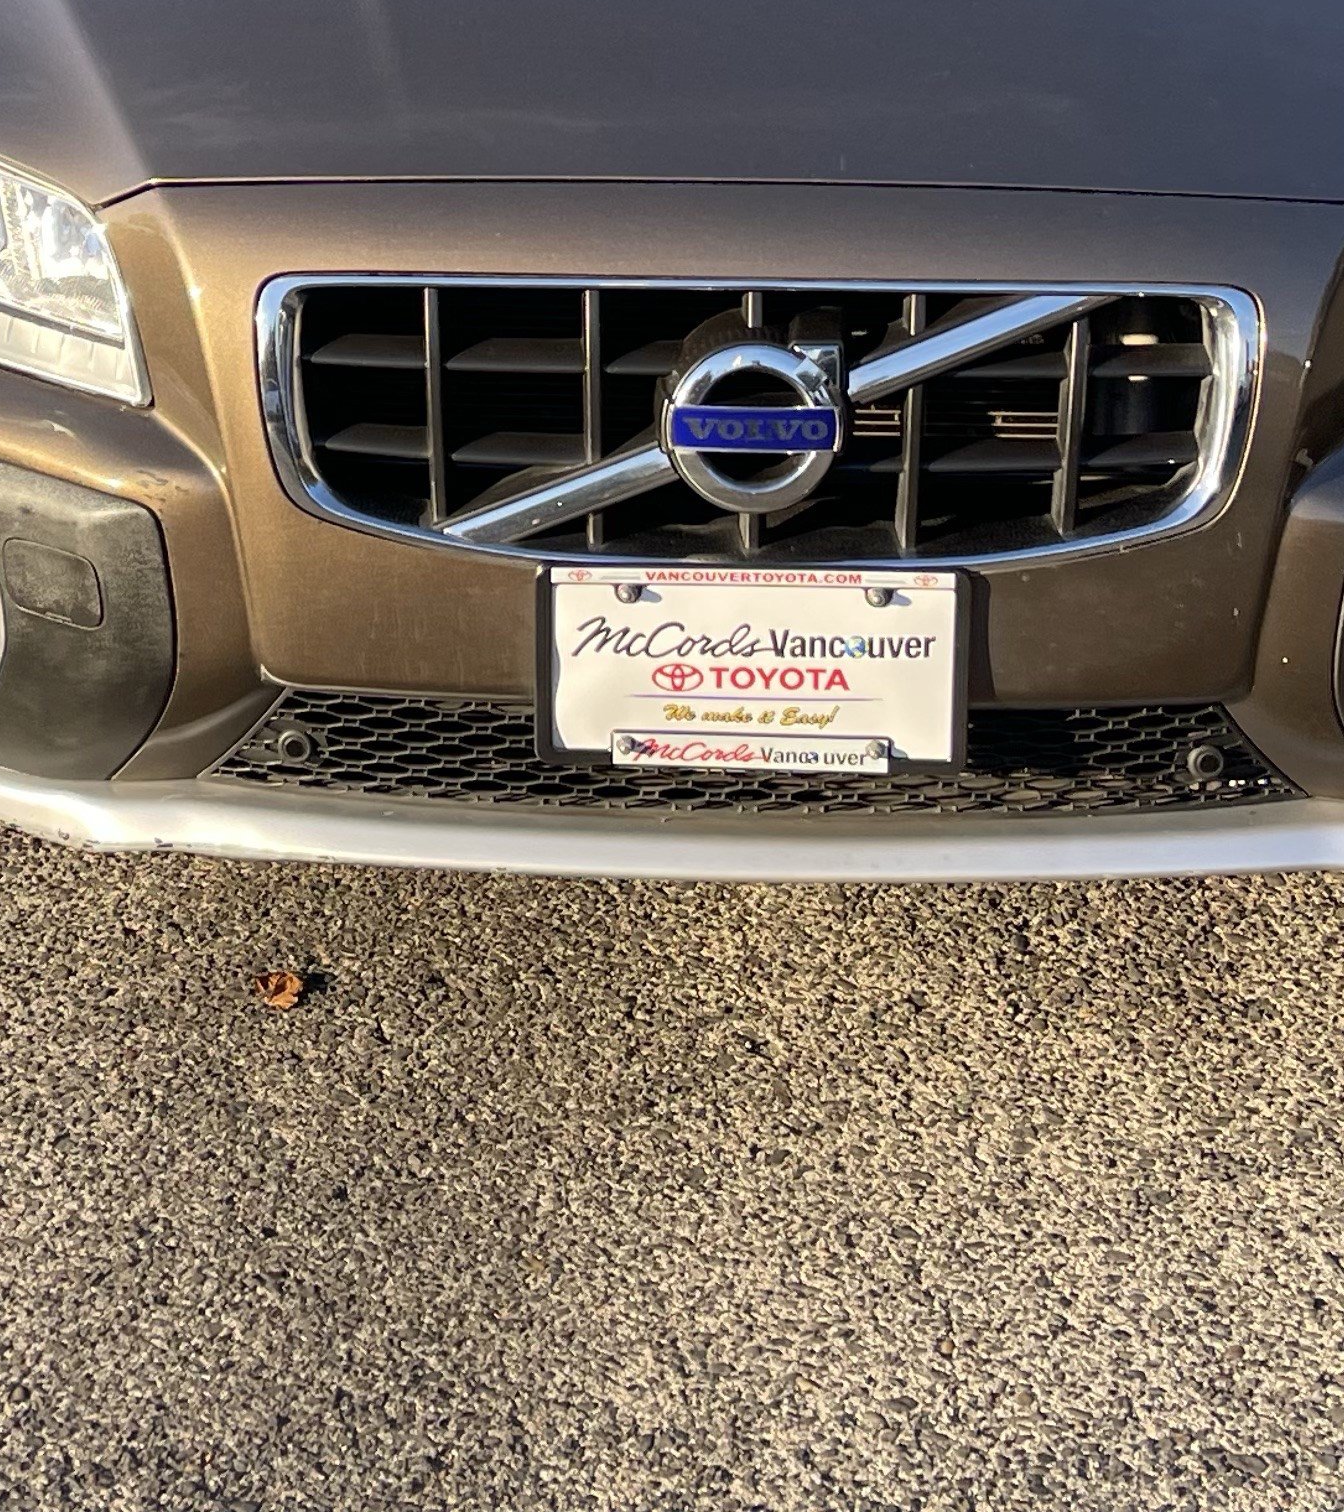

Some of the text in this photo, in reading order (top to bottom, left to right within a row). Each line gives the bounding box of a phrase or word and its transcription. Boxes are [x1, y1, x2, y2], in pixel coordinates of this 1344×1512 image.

[682, 417, 829, 441] VOLVO
[645, 571, 862, 585] VANCOUVERTOYOTA.COM
[768, 628, 937, 660] Vancouver
[709, 666, 851, 691] TOYOTA
